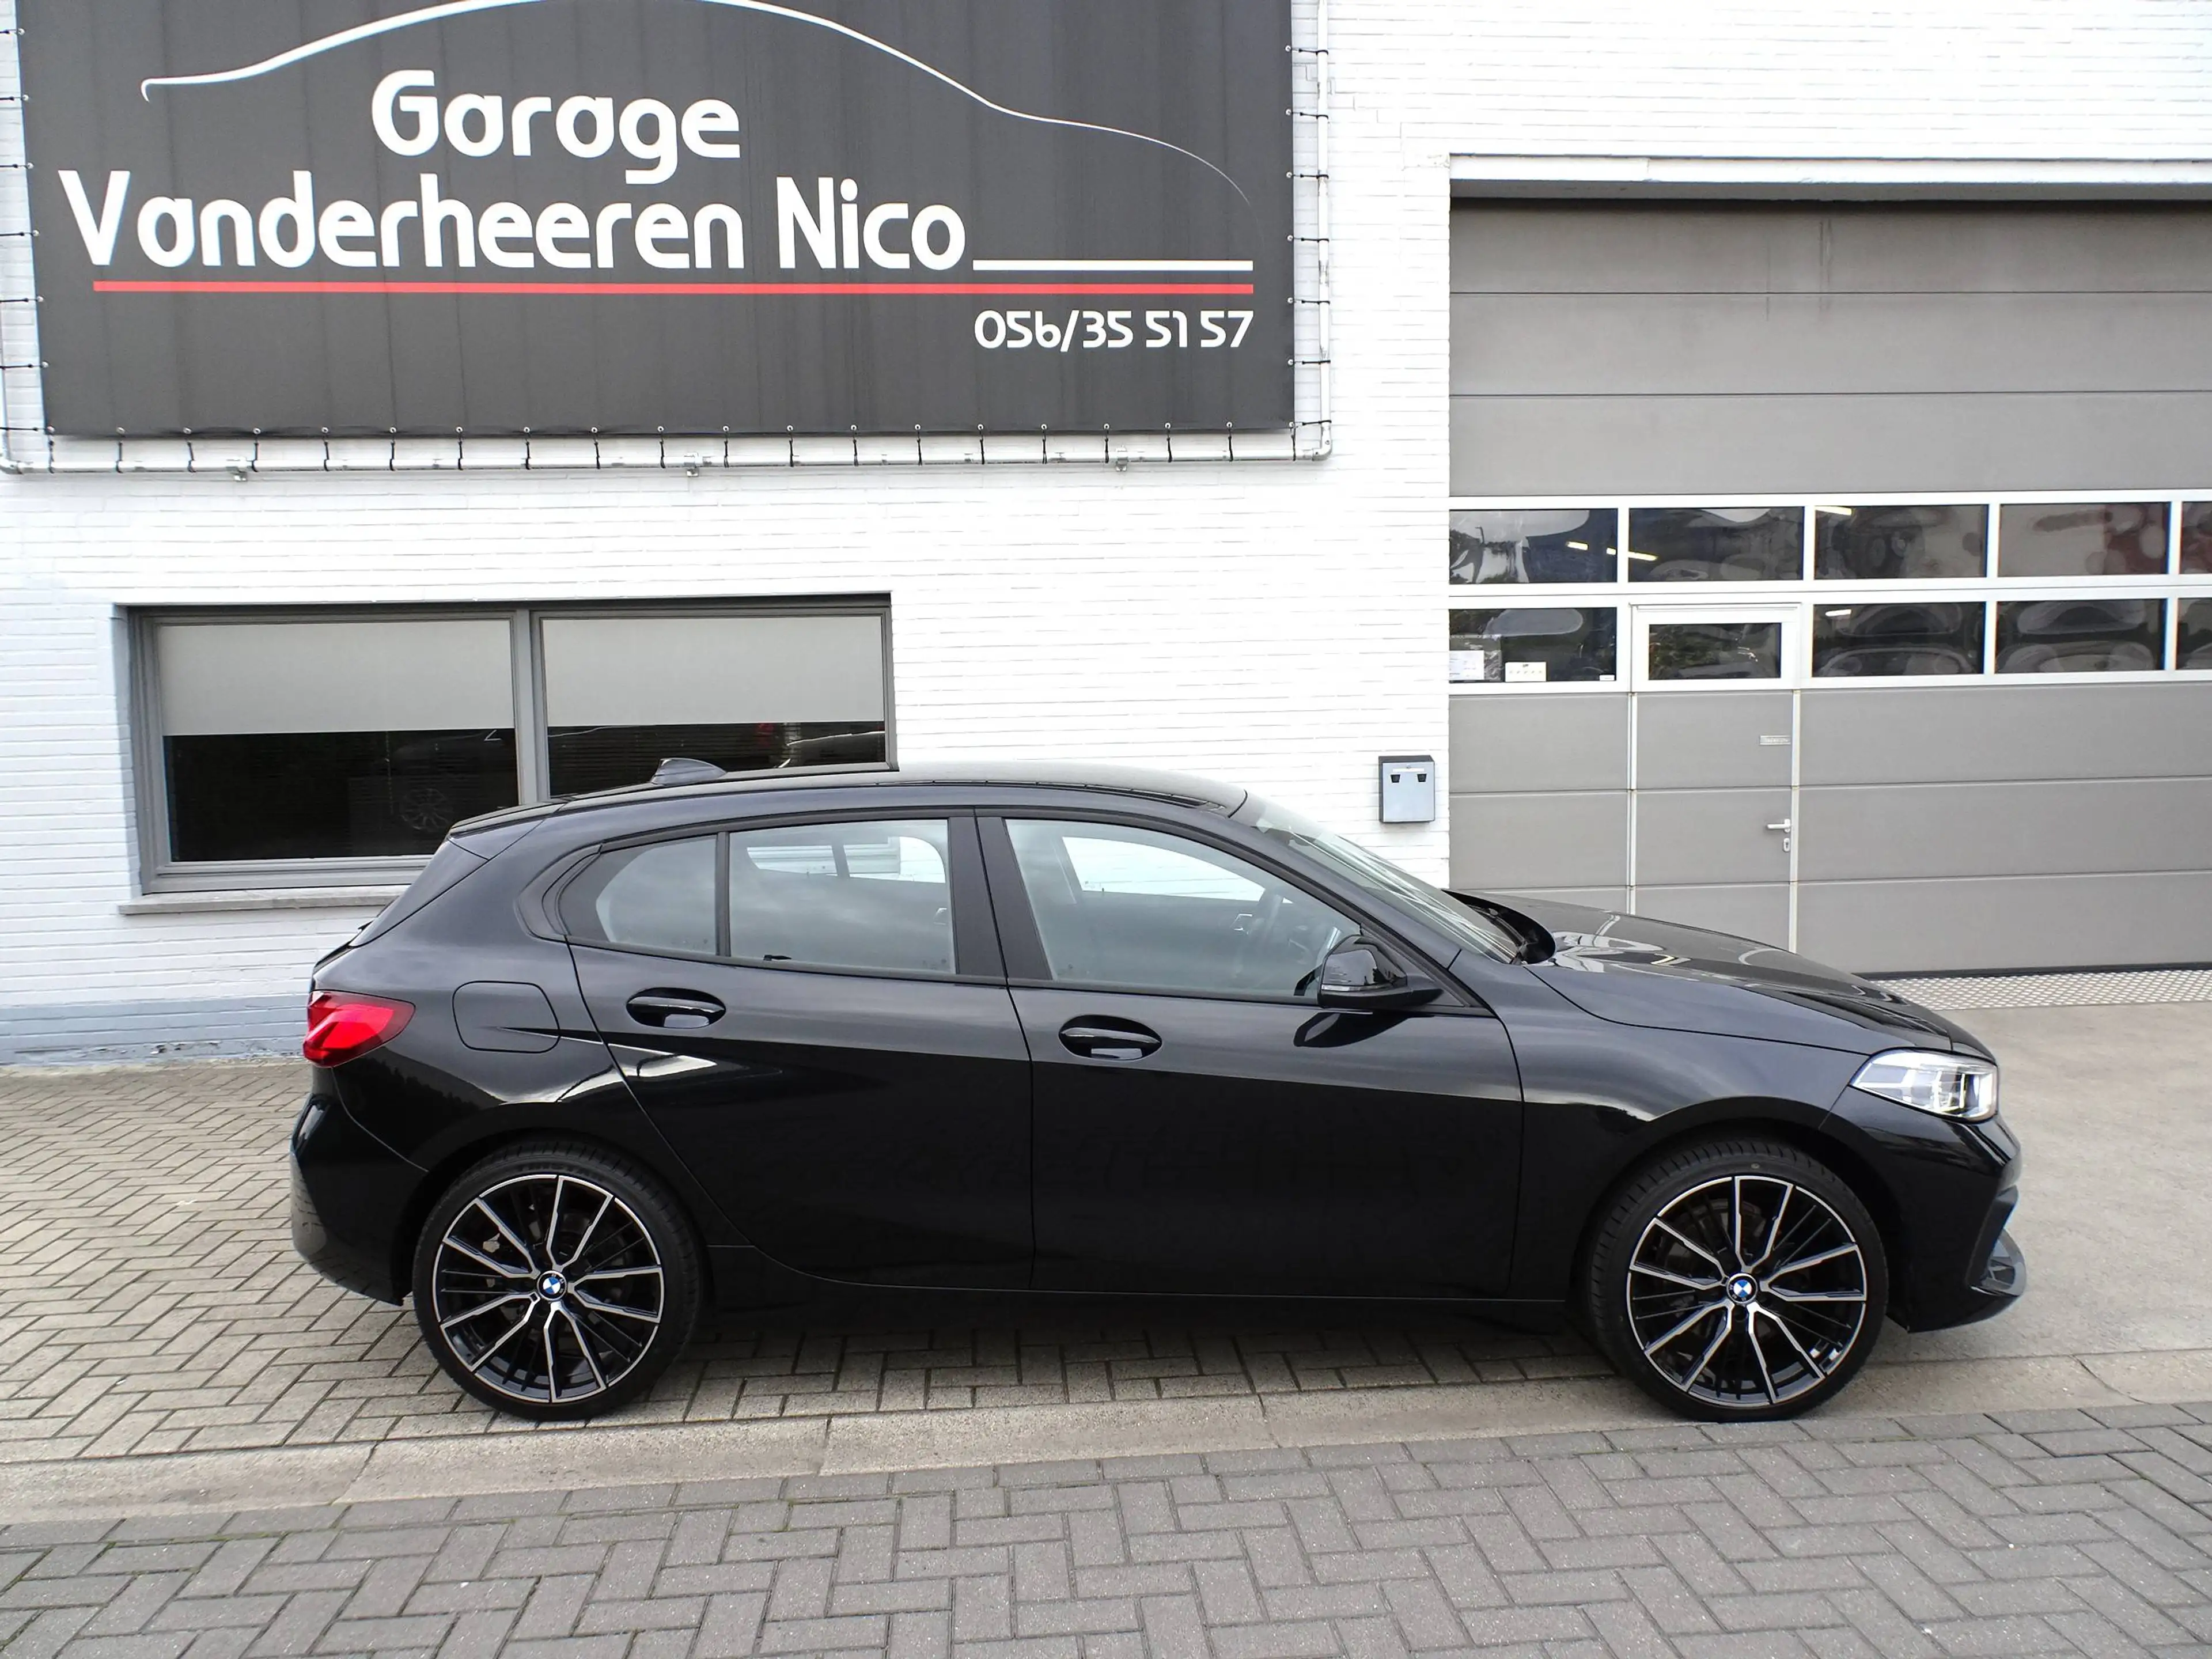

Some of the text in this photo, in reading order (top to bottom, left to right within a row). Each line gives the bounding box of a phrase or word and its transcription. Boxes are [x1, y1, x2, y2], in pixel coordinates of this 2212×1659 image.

[370, 69, 741, 185] Garage
[57, 169, 966, 271] Vanderheeren Nico
[974, 309, 1255, 353] 056/35 51 57
